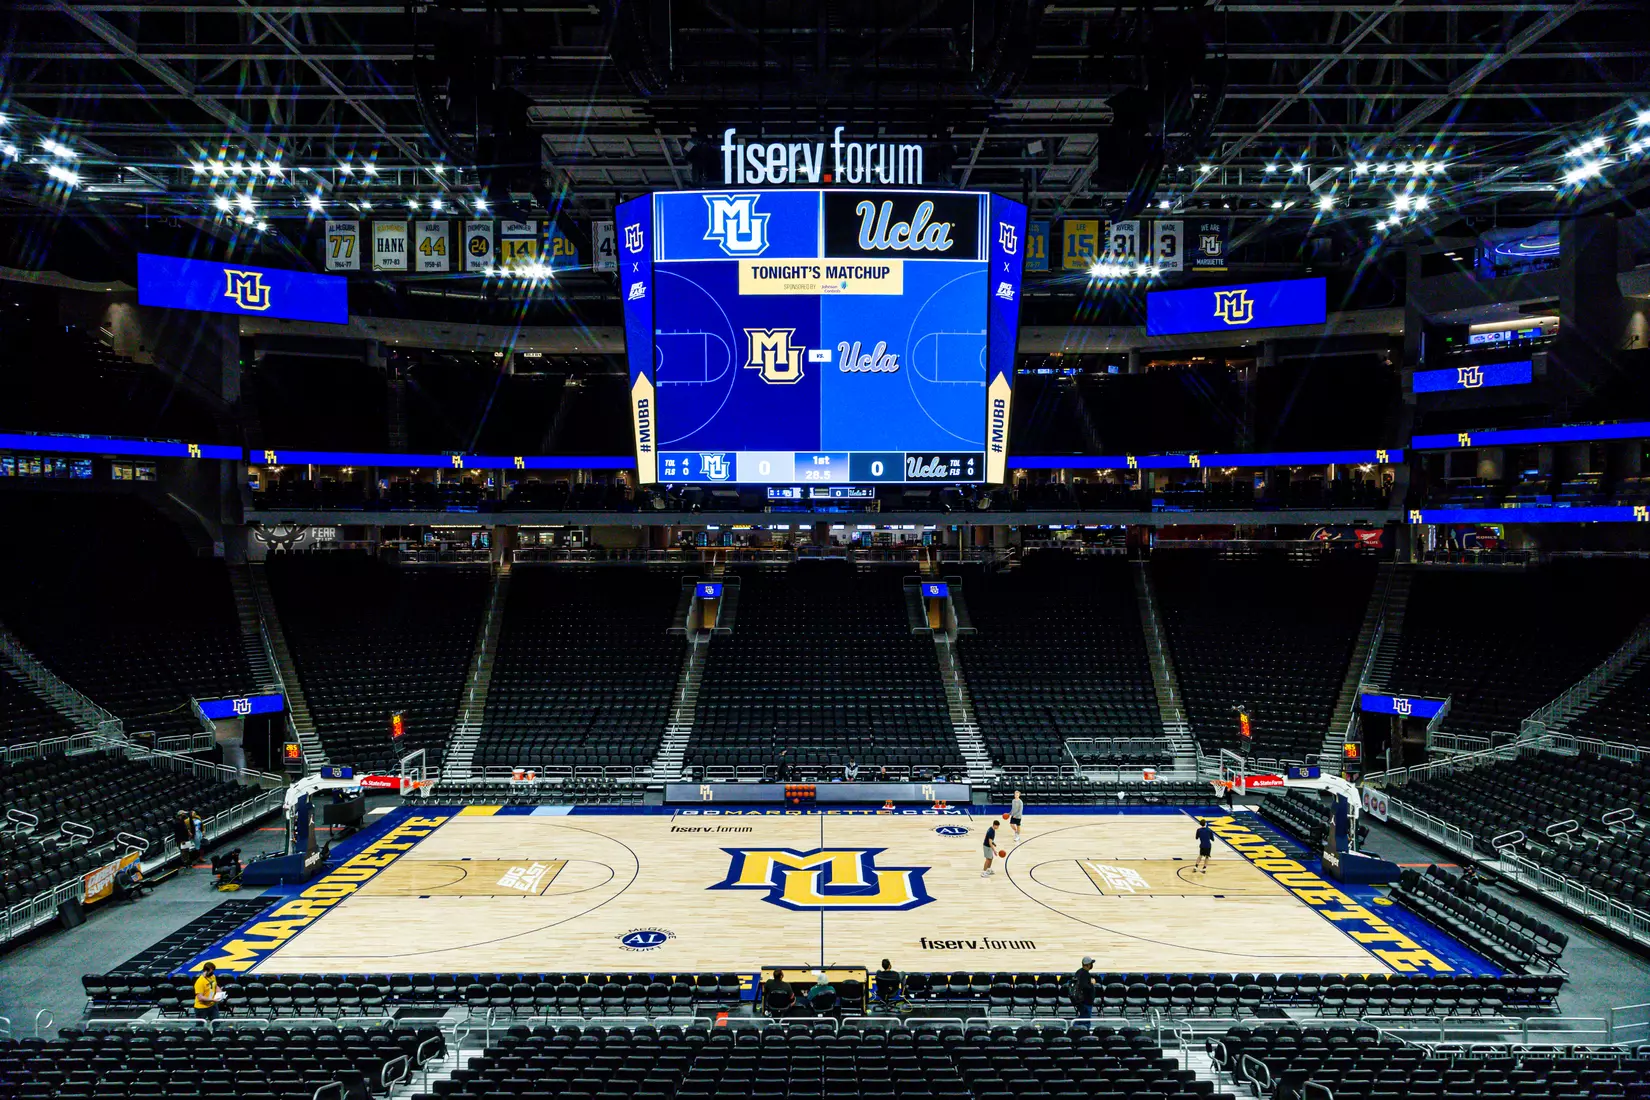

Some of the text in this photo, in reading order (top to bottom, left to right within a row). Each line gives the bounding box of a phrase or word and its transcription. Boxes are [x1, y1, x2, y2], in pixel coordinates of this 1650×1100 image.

[703, 194, 771, 255] MU
[330, 235, 355, 258] 77
[377, 238, 404, 252] HANK
[419, 237, 446, 256] 44
[471, 240, 487, 253] 24
[624, 223, 644, 253] MU
[998, 222, 1017, 254] MU
[1068, 234, 1093, 256] 15
[1114, 235, 1136, 257] 31
[1161, 235, 1176, 257] 3
[1199, 235, 1222, 256] MU
[752, 266, 890, 279] TONIGHT'S MATCHUP
[223, 269, 271, 311] MU
[1213, 289, 1254, 325] MU
[743, 328, 806, 384] MU
[1457, 366, 1483, 387] MU
[638, 398, 651, 453] #MUBB
[991, 398, 1005, 453] #MUBB
[682, 458, 689, 466] 4
[700, 454, 730, 480] MU
[759, 461, 771, 475] 0
[871, 461, 883, 476] 0
[967, 458, 974, 466] 4
[806, 471, 831, 480] 28.5
[312, 528, 335, 537] FEAR
[233, 698, 251, 715] MU
[1393, 698, 1411, 715] MU
[705, 848, 937, 911] MU
[189, 816, 449, 972] MARQUETTE
[1195, 816, 1455, 972] MARQUETTE
[624, 933, 665, 944] AL
[919, 937, 1036, 949] fiserv.forum
